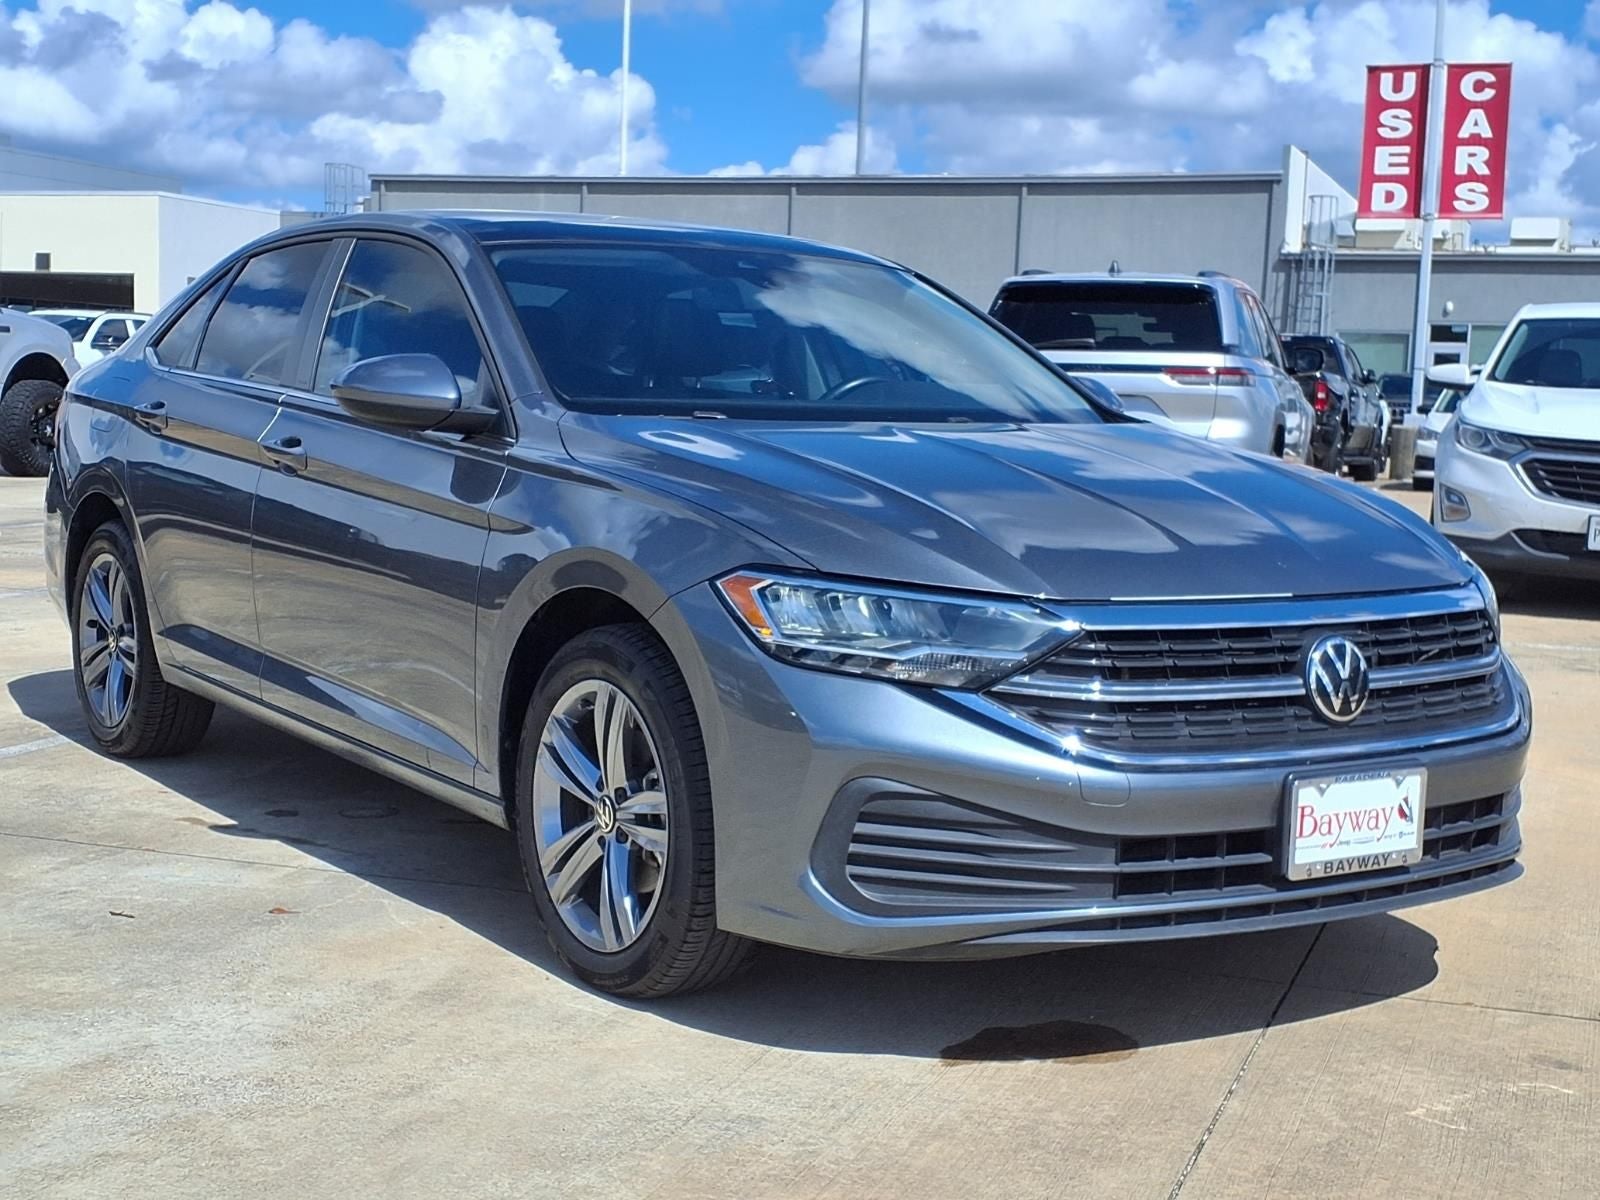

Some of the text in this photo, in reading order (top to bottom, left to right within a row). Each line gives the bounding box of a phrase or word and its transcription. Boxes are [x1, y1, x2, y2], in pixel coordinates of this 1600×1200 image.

[1370, 71, 1417, 213] USED
[1452, 70, 1497, 213] CARS
[1296, 805, 1394, 848] Bayway
[1323, 853, 1391, 875] BAYWAY
